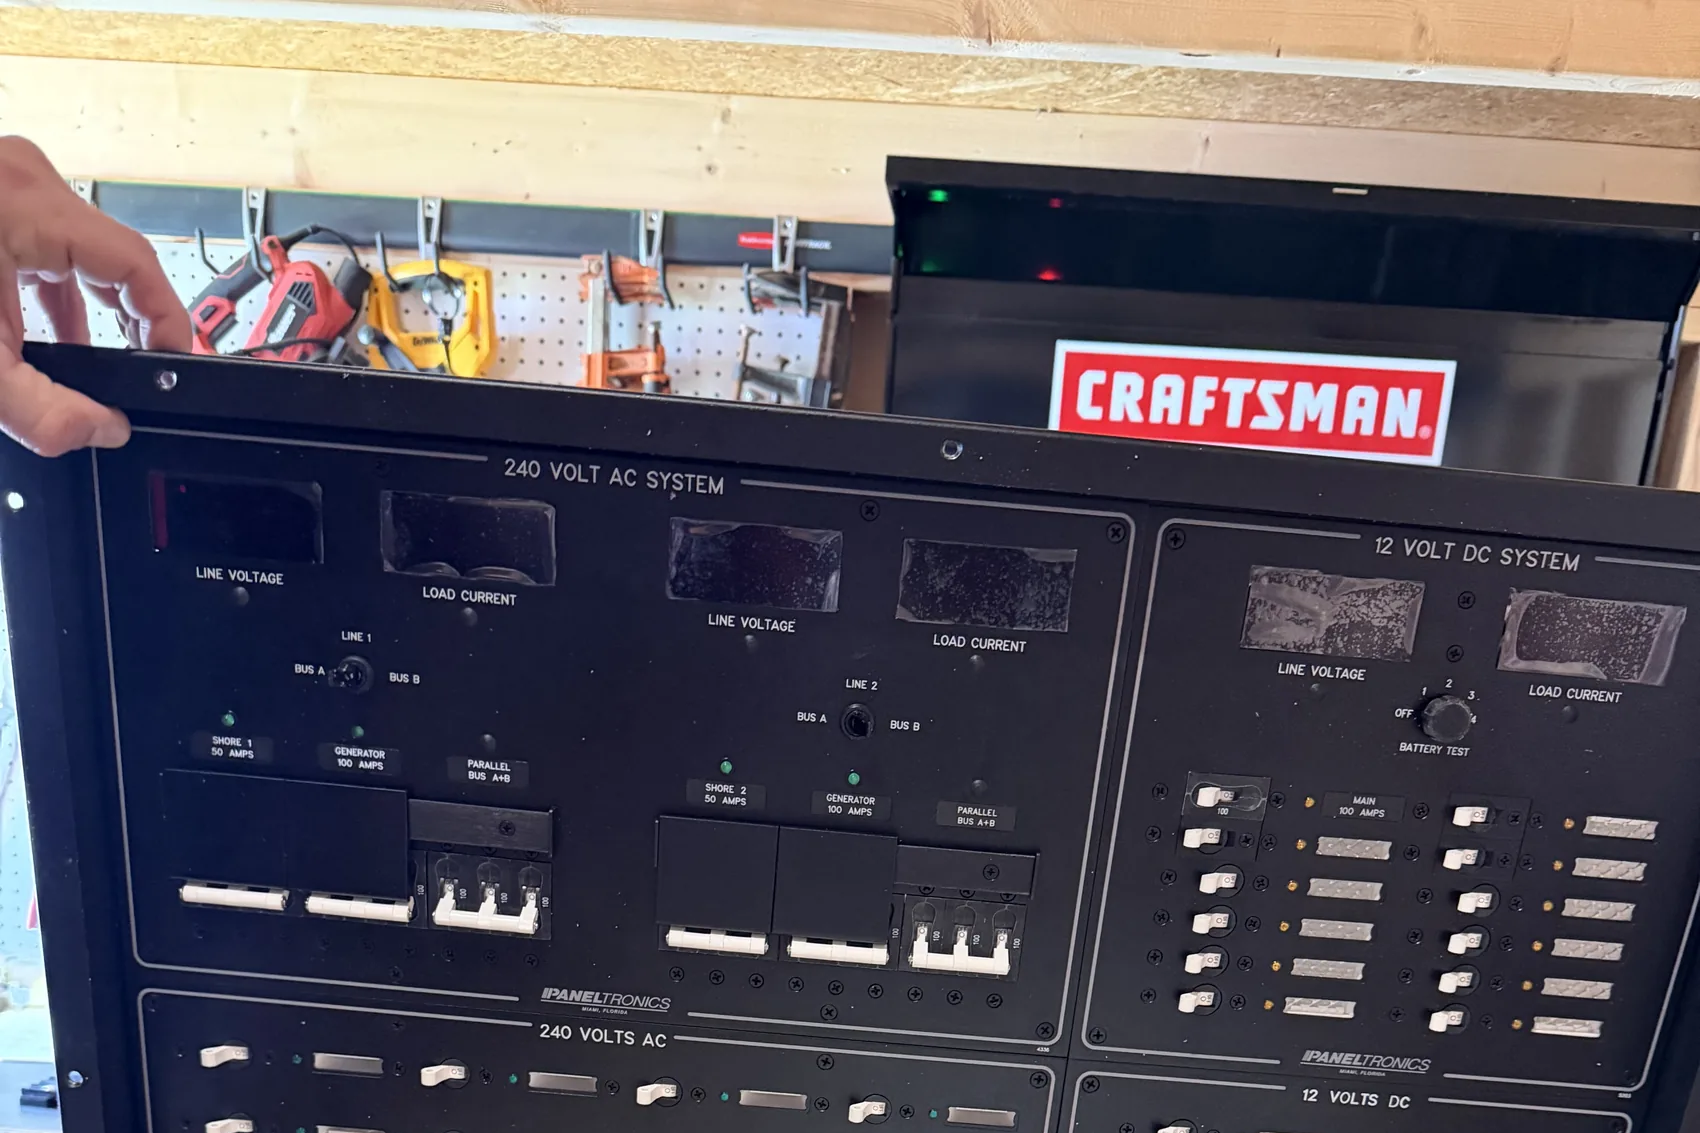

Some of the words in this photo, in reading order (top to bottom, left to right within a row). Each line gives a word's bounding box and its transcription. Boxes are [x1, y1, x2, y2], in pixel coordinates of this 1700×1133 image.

[1076, 370, 1423, 439] CRAFTSMAN
[504, 458, 541, 478] 240
[549, 461, 601, 484] VOLT
[609, 467, 637, 487] AC
[646, 470, 724, 494] SYSTEM
[1375, 536, 1394, 555] 12
[1403, 538, 1456, 560] VOLT
[1462, 543, 1492, 564] DC
[1499, 547, 1581, 572] SYSTEM
[195, 566, 224, 580] LINE
[227, 568, 284, 586] VOLTAGE
[422, 586, 456, 601] LOAD
[460, 589, 517, 606] CURRENT
[708, 613, 736, 628] LINE
[740, 616, 796, 633] VOLTAGE
[341, 630, 364, 642] LINE
[367, 633, 372, 643] 1
[933, 633, 966, 648] LOAD
[970, 637, 1027, 653] CURRENT
[294, 663, 315, 675] BUS
[317, 665, 326, 676] A
[1277, 662, 1307, 676] LINE
[1311, 665, 1367, 681] VOLTAGE
[389, 671, 410, 684] BUS
[412, 674, 421, 685] B
[845, 678, 868, 690] LINE
[870, 680, 878, 691] 2
[1445, 678, 1453, 688] 2
[1422, 686, 1427, 696] 1
[1467, 690, 1476, 700] 3
[1528, 684, 1562, 698] LOAD
[1566, 687, 1623, 703] CURRENT
[797, 711, 817, 723] BUS
[819, 713, 828, 724] A
[1394, 707, 1414, 719] OFF
[889, 719, 910, 731] BUS
[912, 721, 921, 732] B
[212, 735, 242, 747] SHORE
[247, 738, 252, 748] 1
[211, 746, 224, 757] 50
[228, 748, 255, 759] AMPS
[334, 746, 386, 760] GENERATOR
[1399, 741, 1443, 755] BATTERY
[1446, 745, 1471, 757] TEST
[337, 758, 353, 768] 100
[358, 760, 384, 771] AMPS
[467, 758, 511, 772] PARALLEL
[467, 770, 487, 781] BUS
[492, 773, 511, 783] A+B
[705, 782, 735, 794] SHORE
[740, 786, 747, 795] 2
[704, 794, 717, 804] 50
[721, 796, 747, 806] AMPS
[825, 793, 876, 806] GENERATOR
[1352, 795, 1377, 806] MAIN
[827, 804, 843, 814] 100
[847, 806, 873, 817] AMPS
[957, 806, 998, 818] PARALLEL
[1217, 807, 1229, 816] 100
[1339, 806, 1355, 816] 100
[1359, 808, 1386, 818] AMPS
[957, 816, 975, 826] BUS
[976, 818, 996, 827] A+B
[416, 884, 425, 896] 100
[459, 888, 467, 900] 100
[500, 892, 508, 904] 100
[541, 896, 550, 908] 100
[891, 927, 900, 939] 100
[932, 930, 941, 942] 100
[972, 934, 981, 946] 100
[1012, 937, 1021, 949] 100
[541, 987, 671, 1009] PANELTRONICS
[539, 1023, 572, 1040] 240
[579, 1026, 635, 1046] VOLTS
[642, 1032, 667, 1048] AC
[1302, 1050, 1432, 1071] PANELTRONICS
[1302, 1088, 1319, 1102] 12
[1329, 1090, 1379, 1107] VOLTS
[1388, 1094, 1411, 1109] DC
